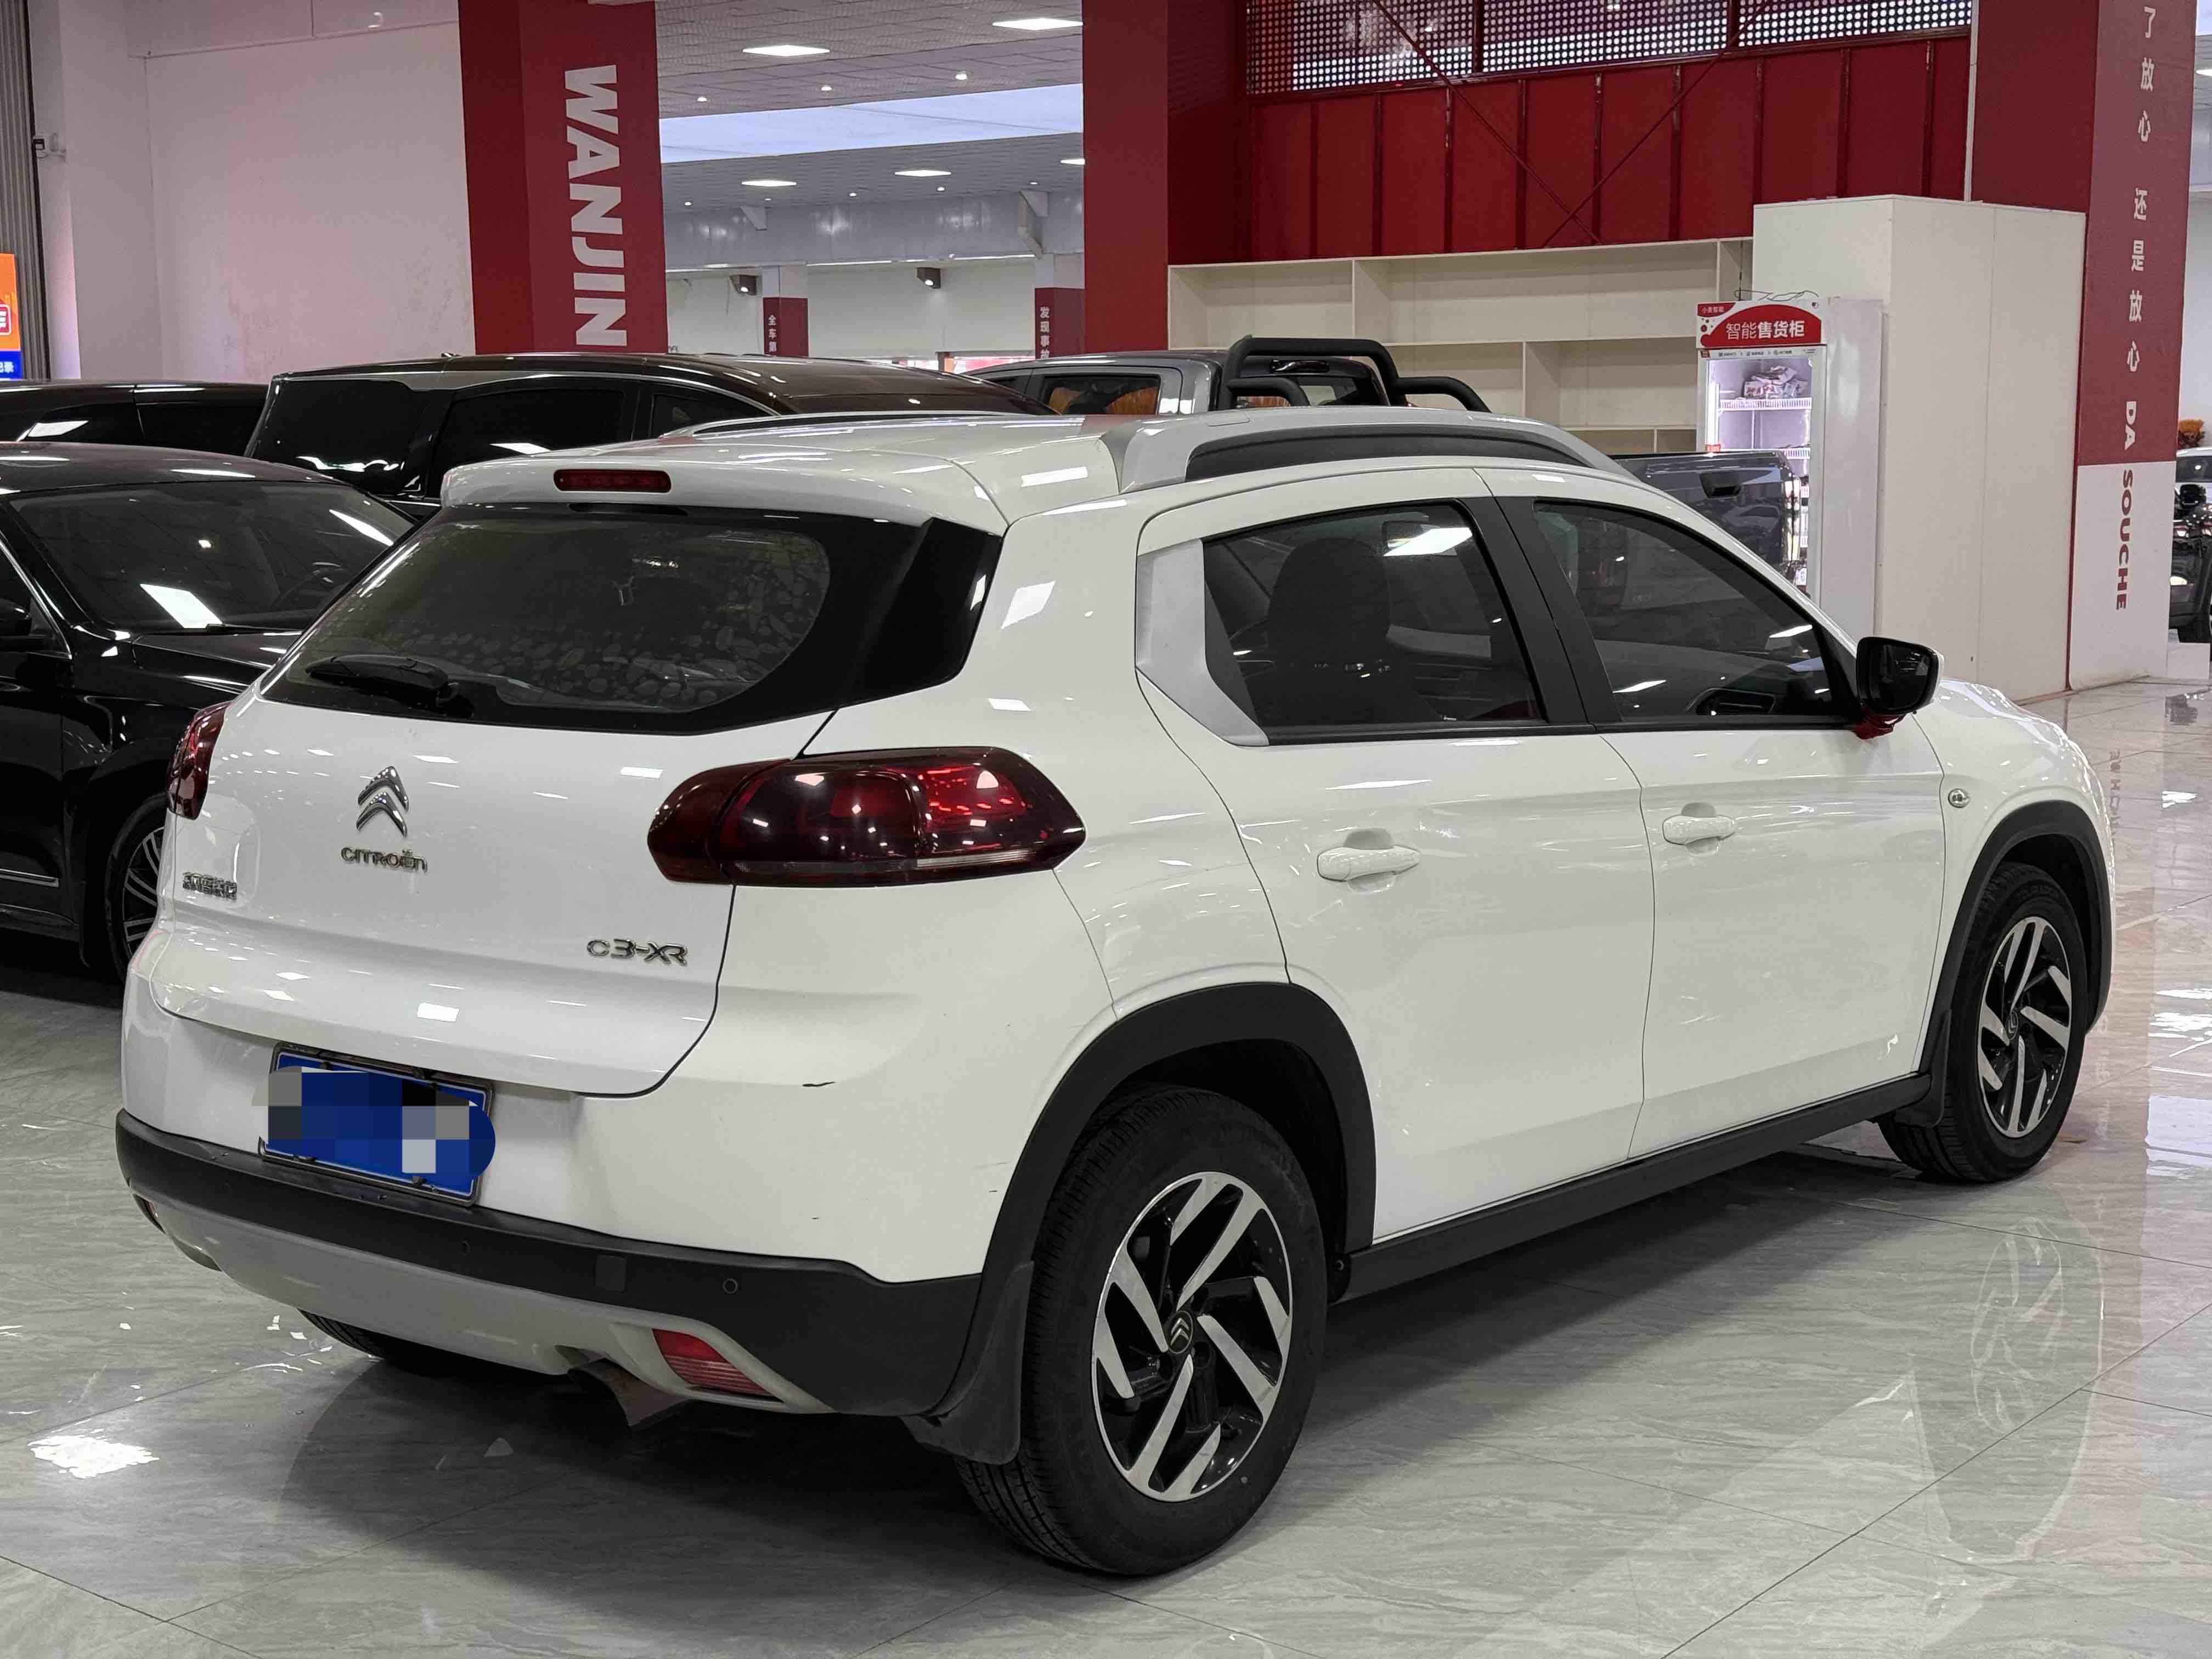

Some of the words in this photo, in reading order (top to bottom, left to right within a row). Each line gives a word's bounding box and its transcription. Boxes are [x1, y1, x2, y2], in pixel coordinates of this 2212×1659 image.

[565, 64, 628, 347] WANJIN
[2126, 188, 2148, 373] 还是放心
[1725, 320, 1805, 340] 智能售货柜
[2124, 400, 2137, 450] DA
[2115, 469, 2134, 611] SOUCHE
[586, 938, 689, 968] C3-XR
